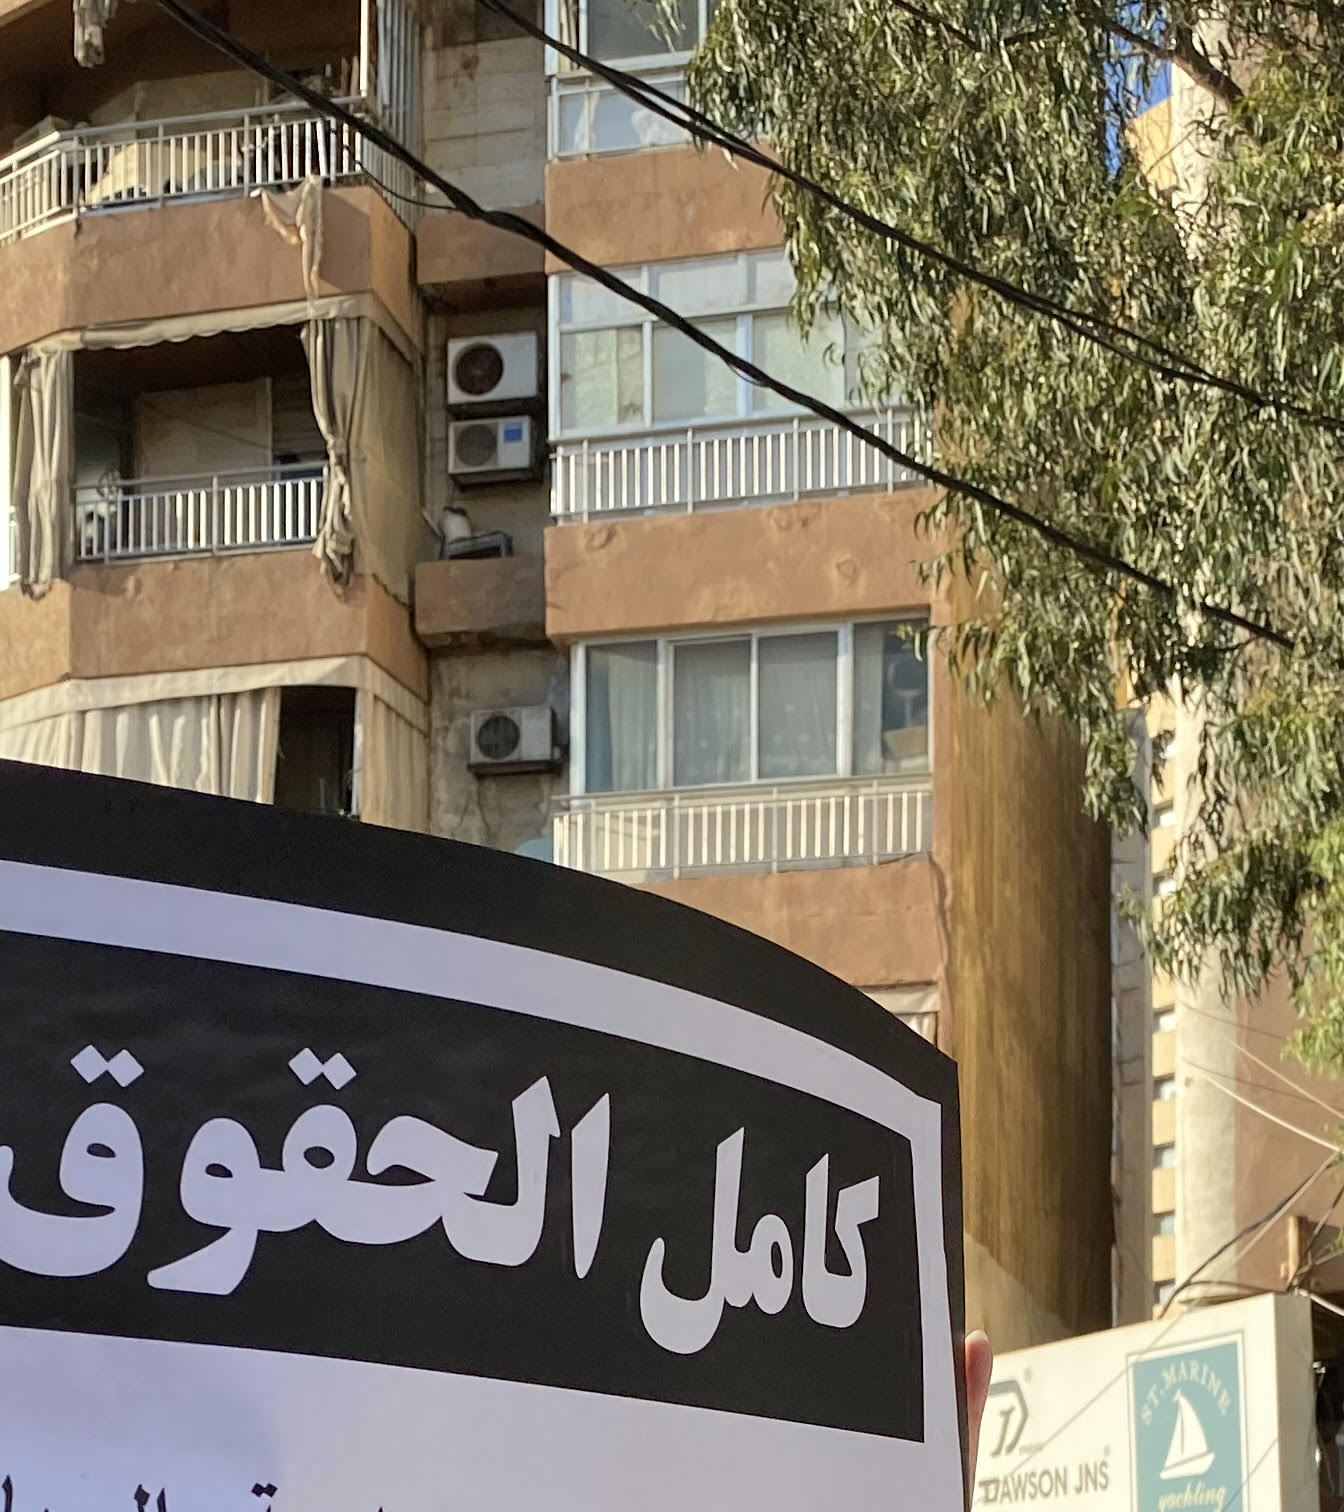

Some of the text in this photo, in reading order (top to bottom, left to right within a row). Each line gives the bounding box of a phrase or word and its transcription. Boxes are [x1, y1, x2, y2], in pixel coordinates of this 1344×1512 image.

[640, 1126, 880, 1355] كامل
[1162, 1359, 1231, 1415] MARINE
[978, 1459, 1109, 1504] DAWSON JNS
